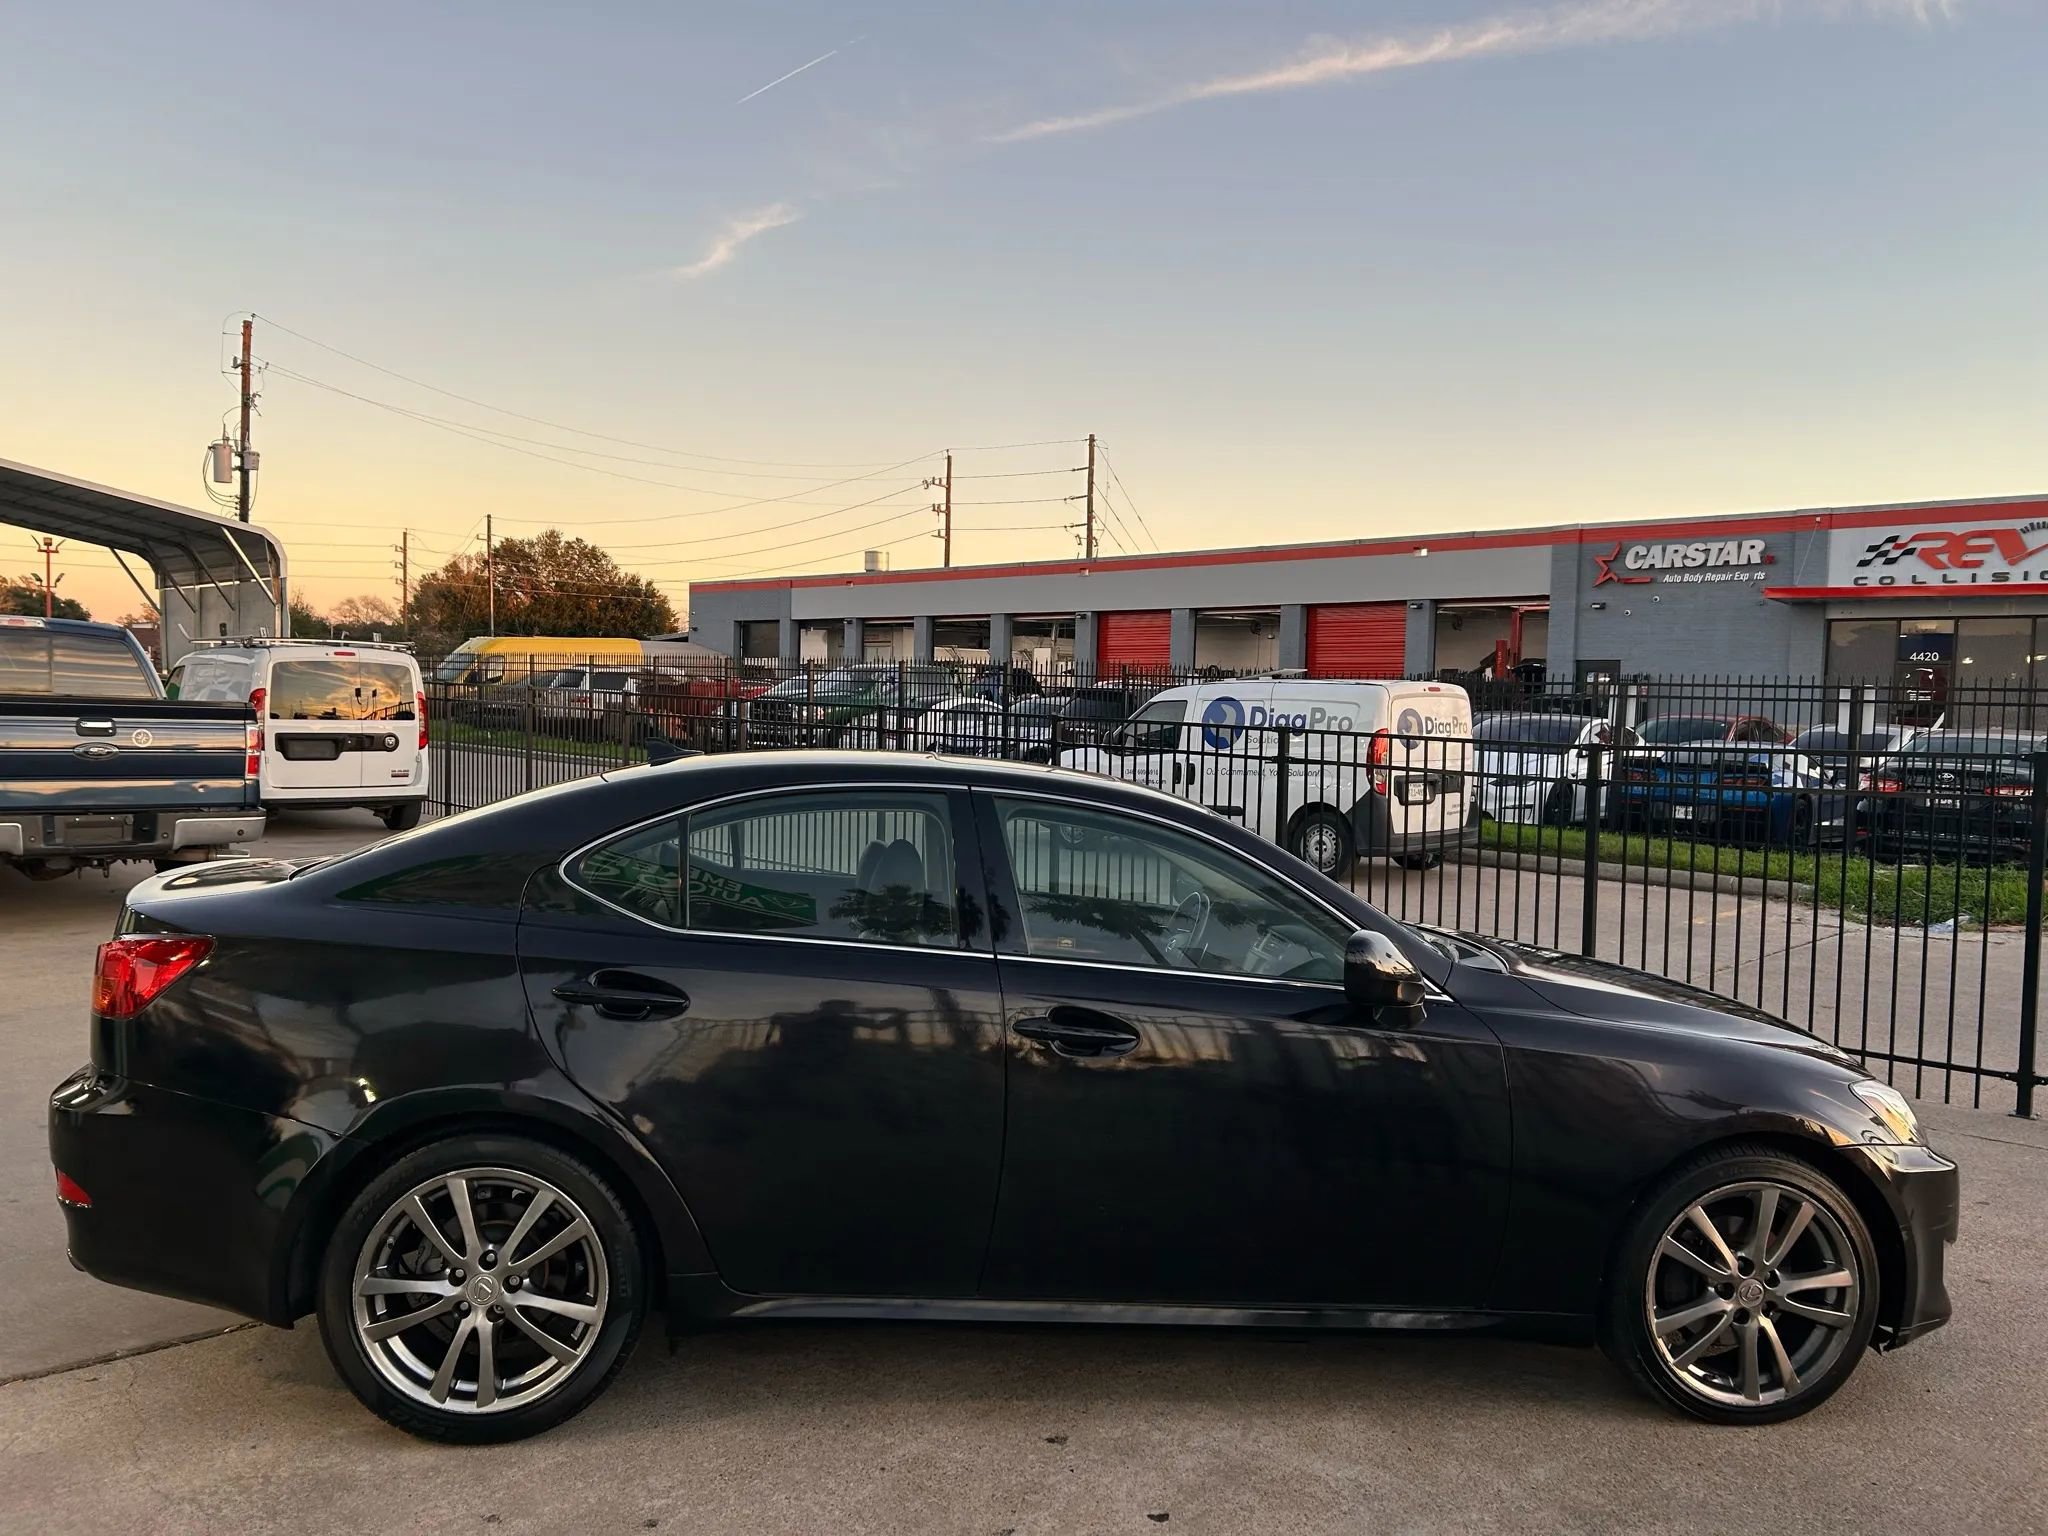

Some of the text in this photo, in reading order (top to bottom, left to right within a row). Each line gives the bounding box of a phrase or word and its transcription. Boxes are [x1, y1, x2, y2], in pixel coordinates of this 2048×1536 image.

[1625, 540, 1765, 570] CARSTAR
[1663, 573, 1681, 583] Auto
[1683, 572, 1703, 583] Body
[1705, 572, 1732, 582] Repair
[1909, 652, 1939, 661] 4420
[1250, 706, 1353, 736] DiagPro
[1424, 716, 1467, 736] DiagPro
